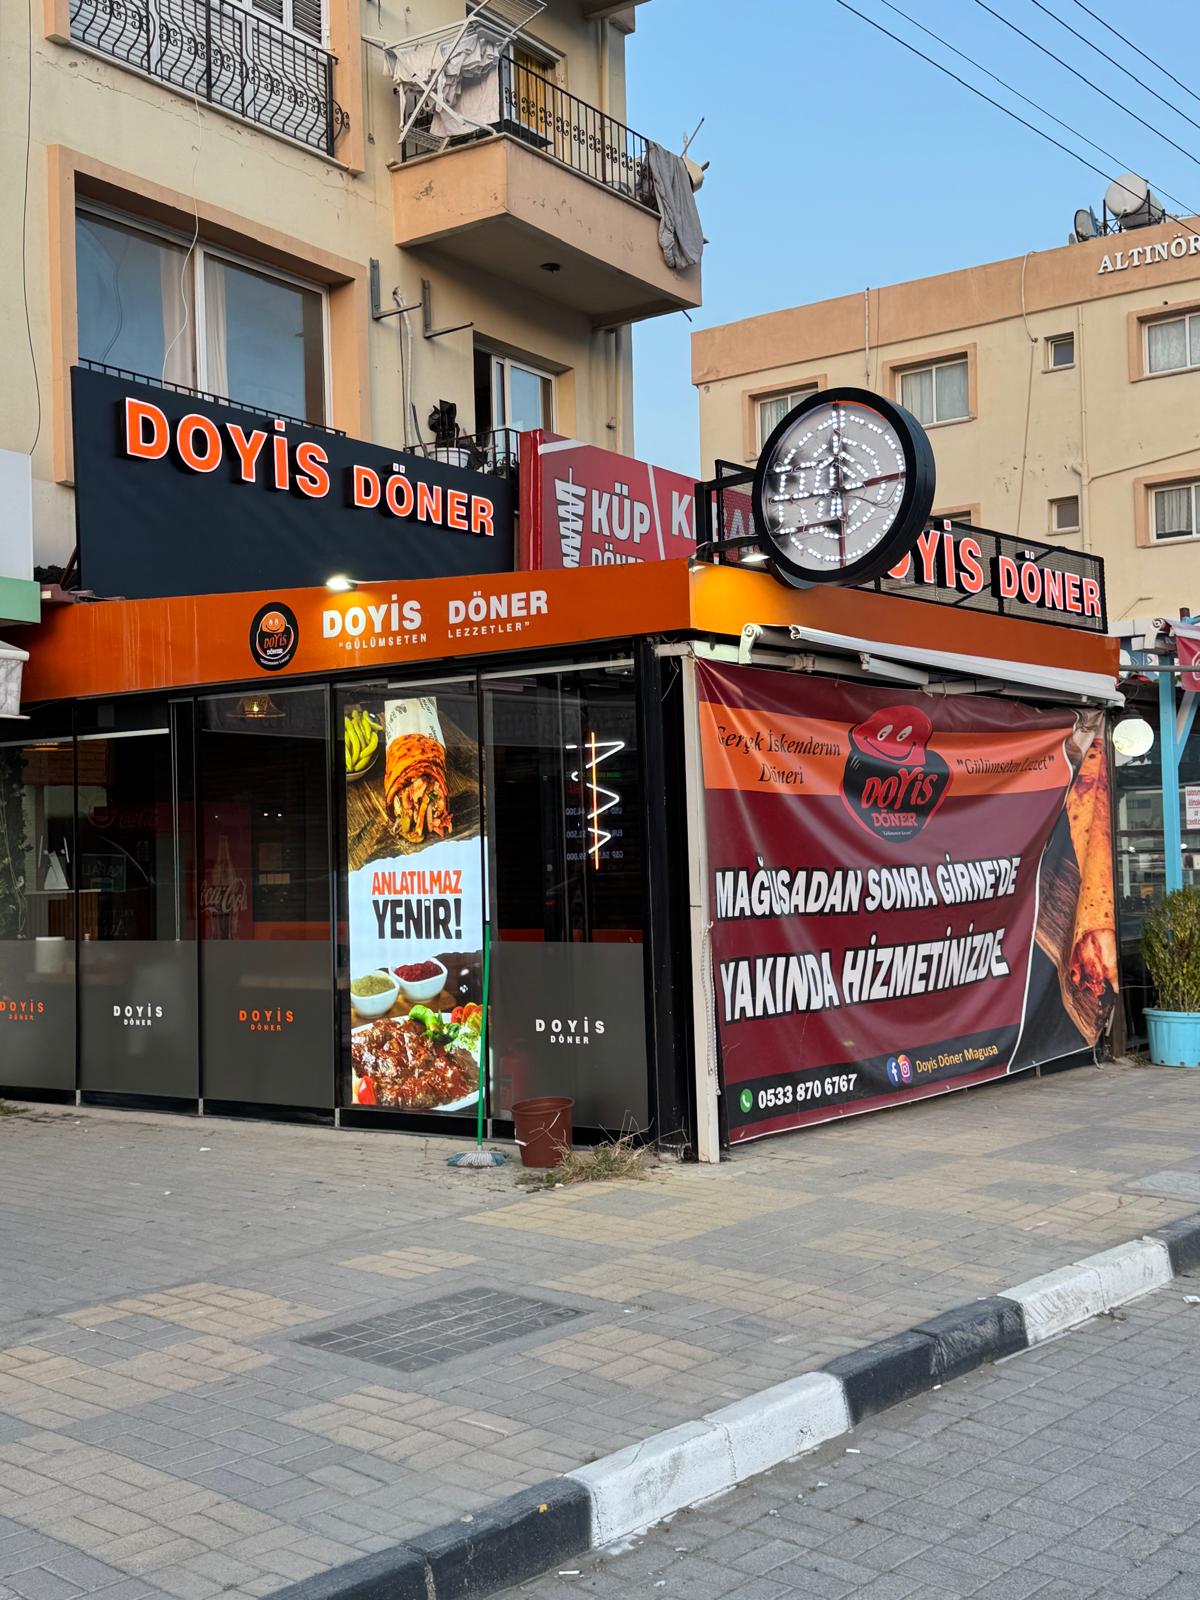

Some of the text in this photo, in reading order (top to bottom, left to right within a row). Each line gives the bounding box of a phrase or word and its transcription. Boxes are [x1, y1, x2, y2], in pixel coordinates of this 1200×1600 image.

[1097, 233, 1200, 274] ALTINÖR
[124, 397, 495, 537] DOYİS DÖNER
[591, 481, 651, 544] KÜP
[999, 550, 1102, 617] DÖNER
[322, 591, 548, 638] DOYİS DÖNER
[758, 762, 804, 785] Döneri
[871, 809, 918, 828] DÖNER
[372, 870, 462, 896] ANLATILMAZ
[716, 853, 1022, 919] MAĞUSADAN SONRA GİRNE'DE
[372, 898, 462, 939] YENİR!
[720, 922, 1010, 1022] YAKINDA HİZMETİNİZDE
[0, 999, 44, 1013] DOYİS
[113, 1003, 163, 1018] DOYİS
[239, 1007, 294, 1022] DOYİS
[123, 1018, 152, 1026] DÖNER
[250, 1023, 282, 1032] DÖNER
[535, 1016, 605, 1034] DOYİS
[550, 1033, 589, 1045] DÖNER
[938, 1051, 963, 1068] Döner
[757, 1073, 858, 1110] 0533 870 6767
